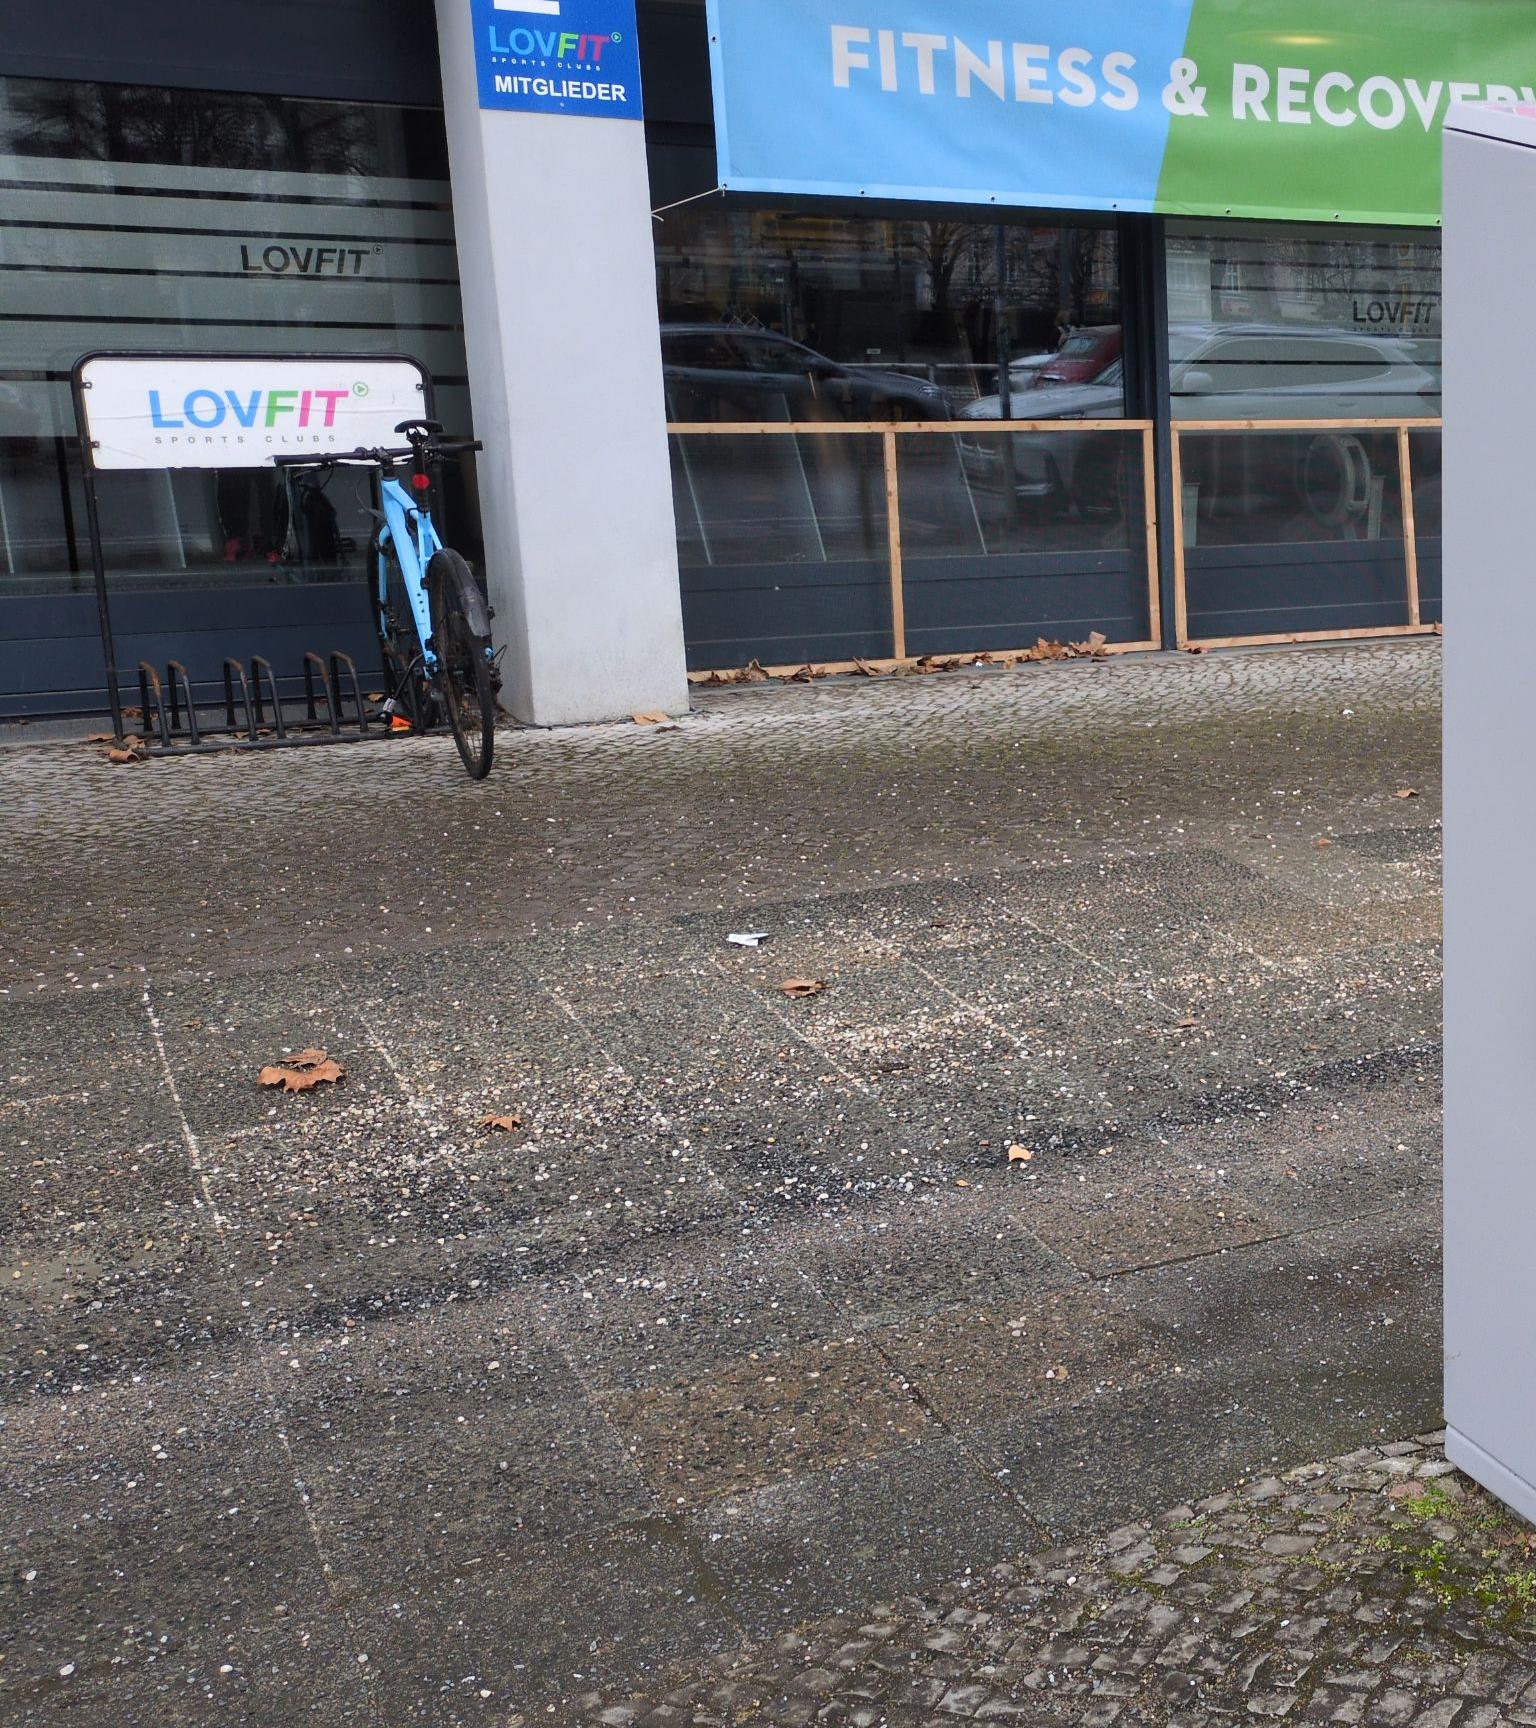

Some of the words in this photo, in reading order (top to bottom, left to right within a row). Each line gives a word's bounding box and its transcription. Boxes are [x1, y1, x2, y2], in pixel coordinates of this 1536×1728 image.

[489, 26, 610, 62] LOVFIT
[492, 57, 545, 67] SPORTS
[557, 63, 601, 71] CLUBS
[831, 24, 1139, 112] FITNESS
[1162, 57, 1209, 117] &
[495, 75, 627, 102] MITGLIEDER
[240, 245, 370, 275] LOVFIT
[1353, 300, 1437, 324] LOVFIT
[148, 389, 349, 429] LOVFIT
[155, 436, 245, 445] SPORTS
[265, 435, 336, 444] CLUBS
